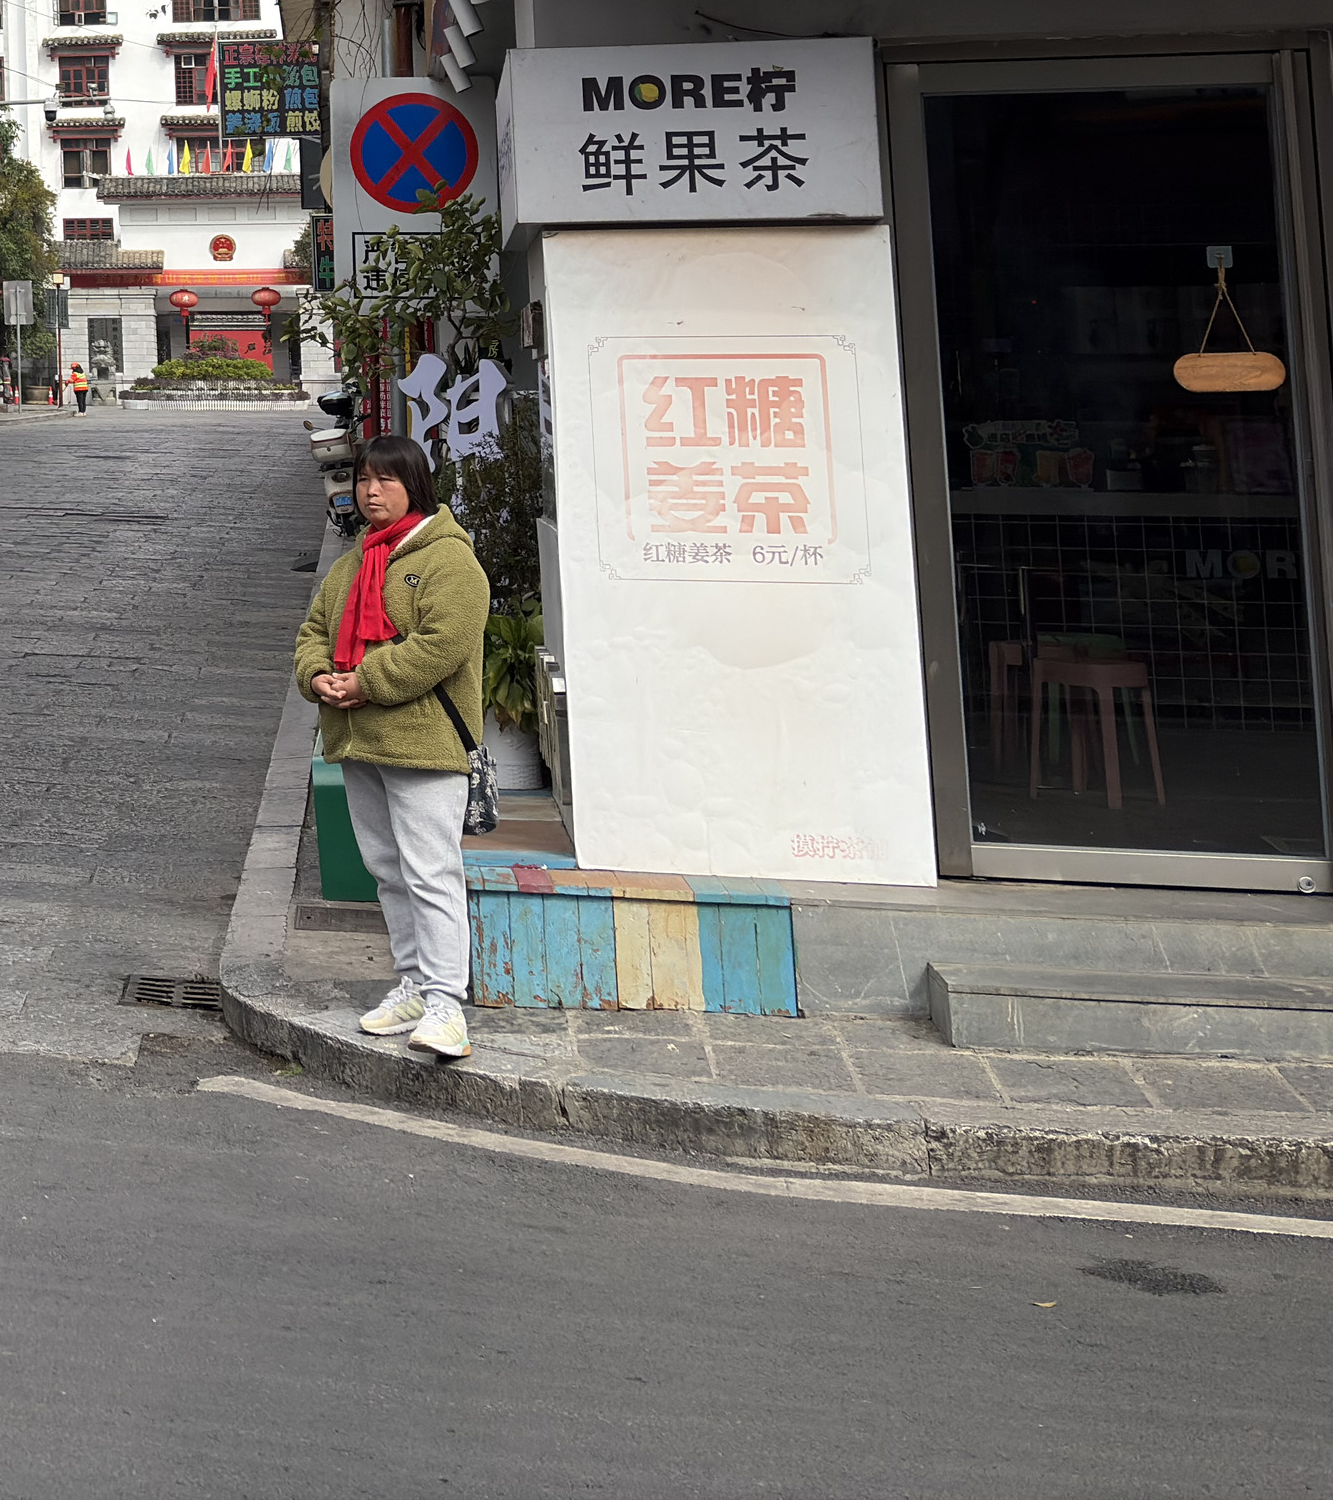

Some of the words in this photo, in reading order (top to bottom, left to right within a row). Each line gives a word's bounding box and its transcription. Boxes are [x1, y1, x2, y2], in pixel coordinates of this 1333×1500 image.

[581, 67, 796, 112] MORE柠
[578, 127, 809, 195] 鲜果茶
[642, 376, 805, 448] 红糖
[646, 461, 810, 534] 姜茶
[643, 542, 733, 565] 红糖姜茶
[752, 543, 824, 567] 6元/杯
